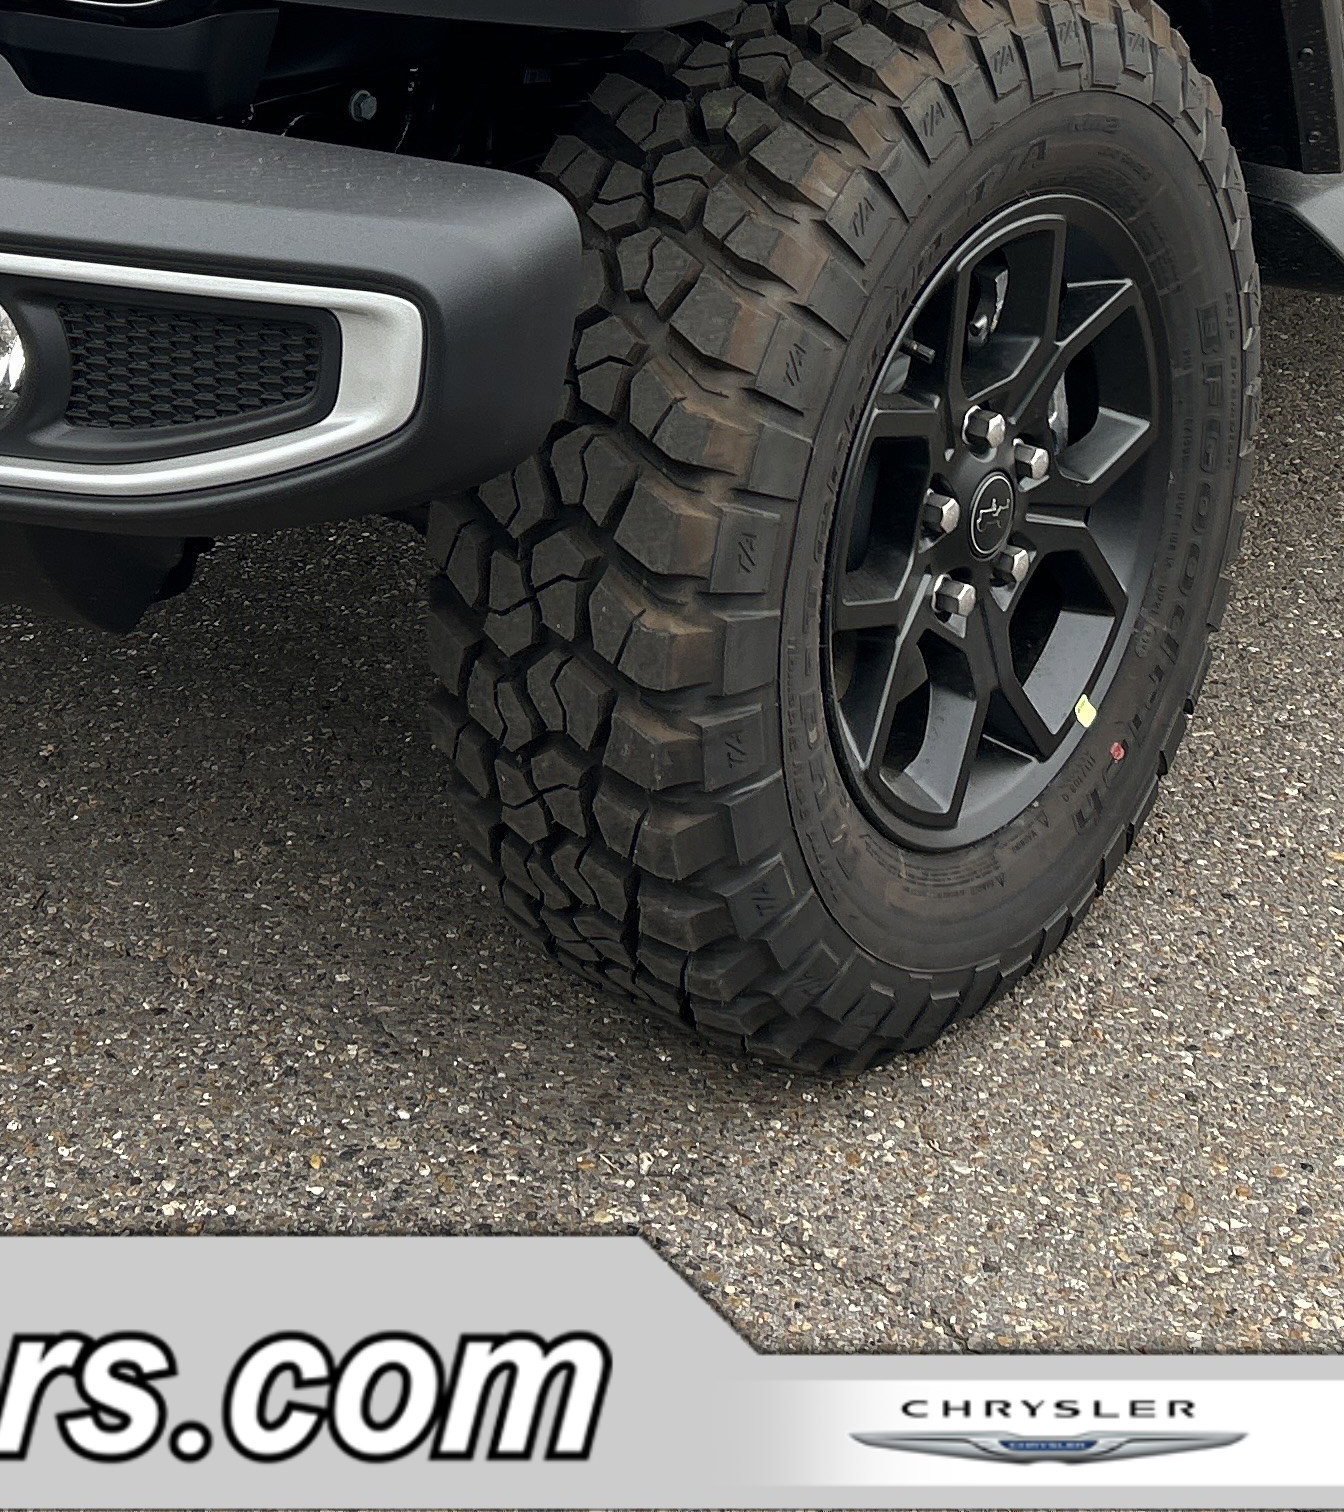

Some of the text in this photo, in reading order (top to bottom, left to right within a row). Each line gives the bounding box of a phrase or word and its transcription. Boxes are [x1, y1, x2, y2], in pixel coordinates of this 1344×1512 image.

[920, 101, 949, 137] T/A
[852, 197, 876, 239] T/A
[782, 342, 807, 384] T/A
[738, 532, 759, 576] T/A
[1072, 300, 1224, 842] BFGoodrich
